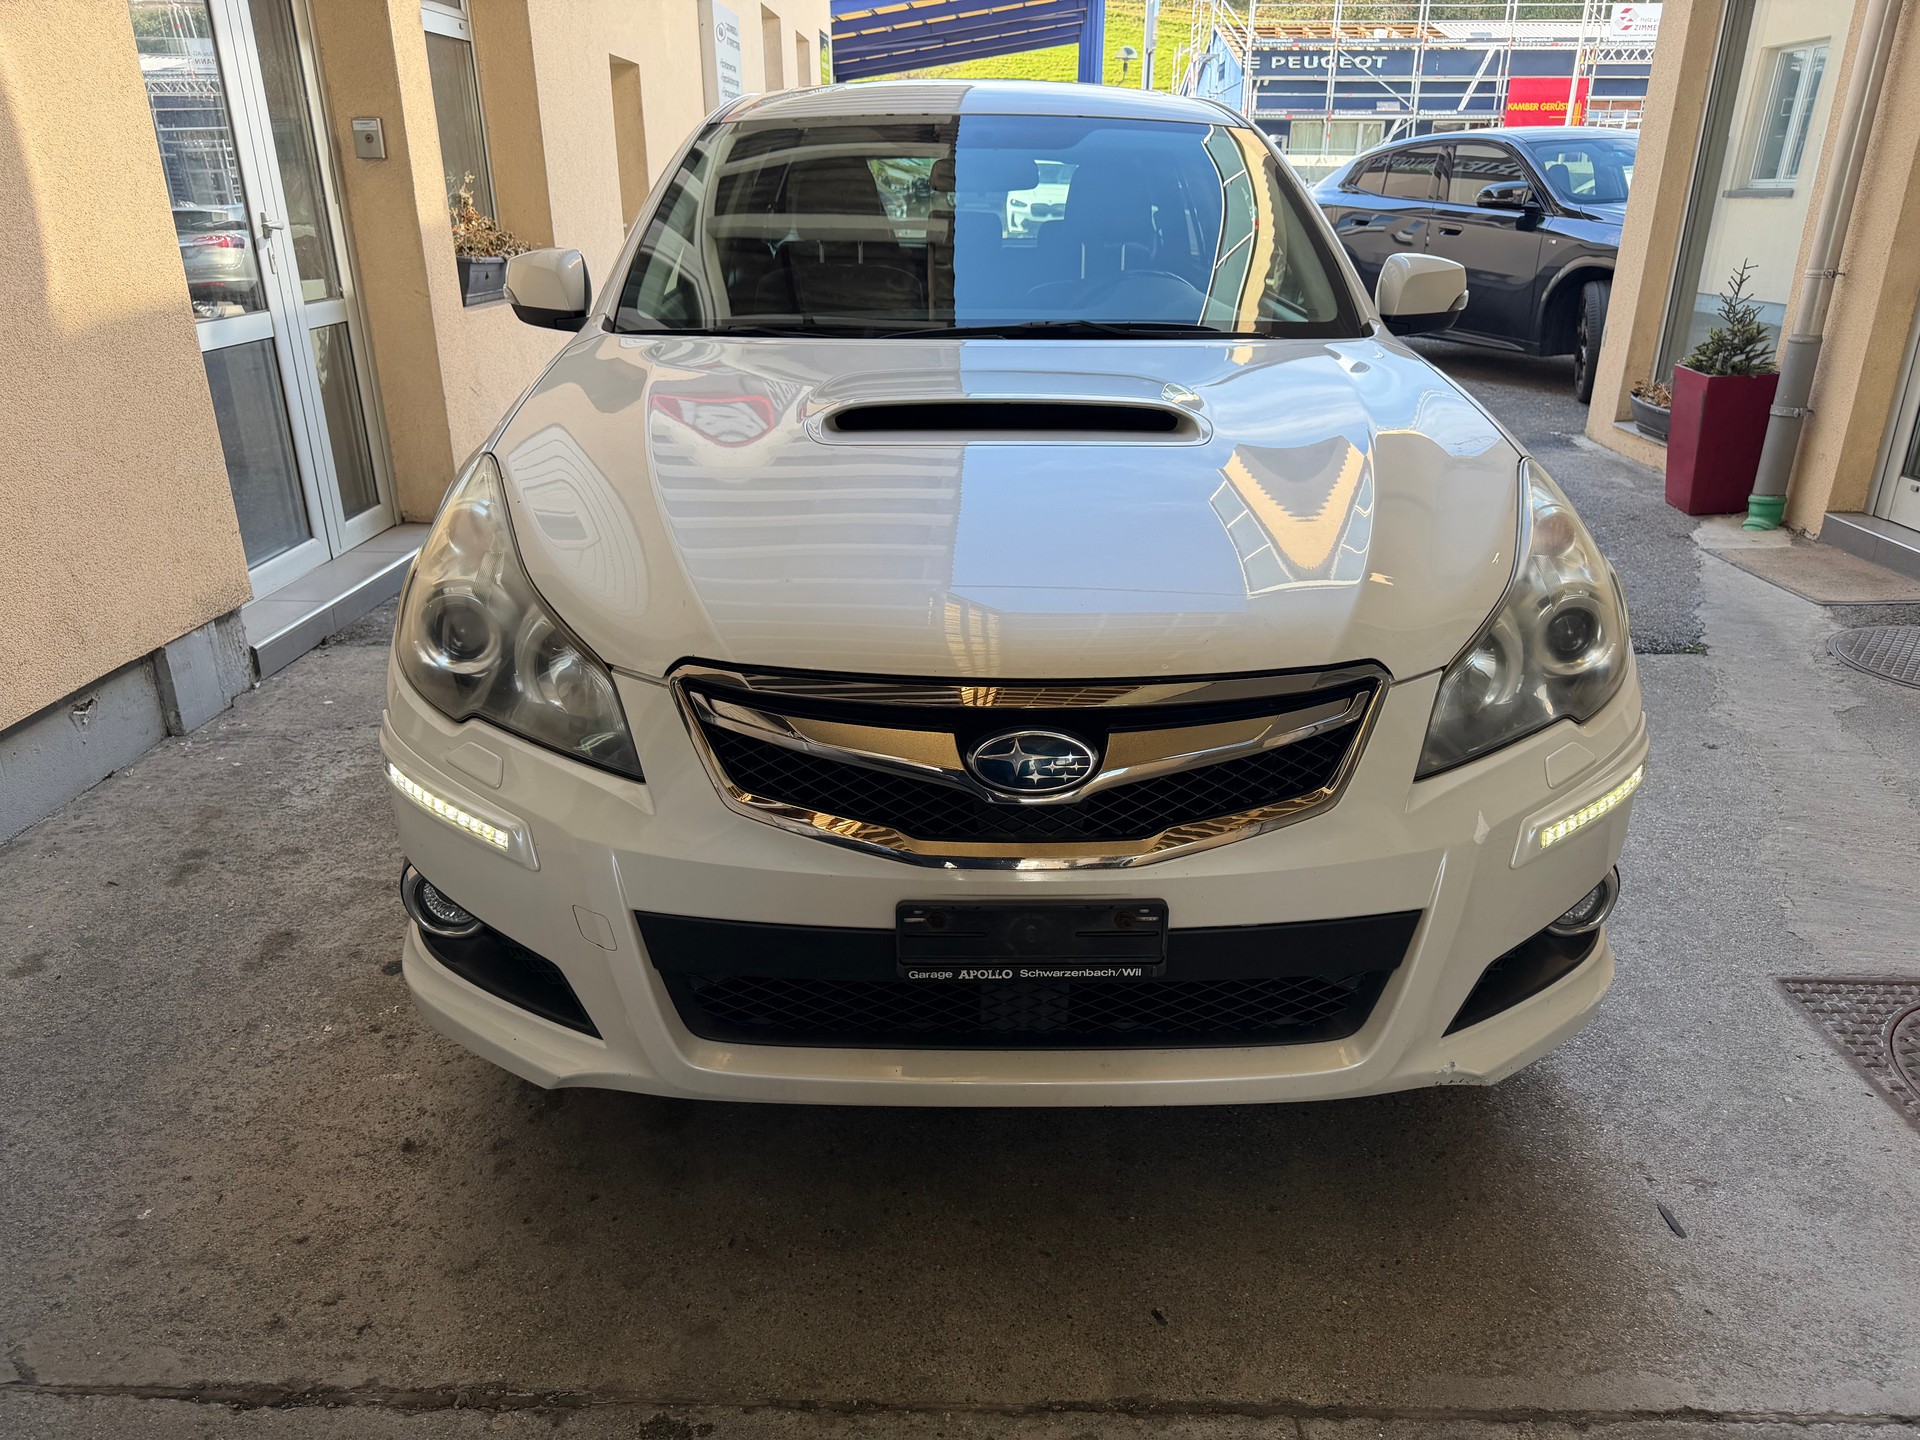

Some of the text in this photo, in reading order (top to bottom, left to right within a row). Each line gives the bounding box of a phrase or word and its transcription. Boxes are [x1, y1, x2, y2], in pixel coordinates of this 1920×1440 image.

[1271, 55, 1388, 69] PEUGEOT
[1507, 102, 1539, 111] KAMBER
[908, 967, 1142, 980] Garage APOLLO Schwarzenbach/Wil
